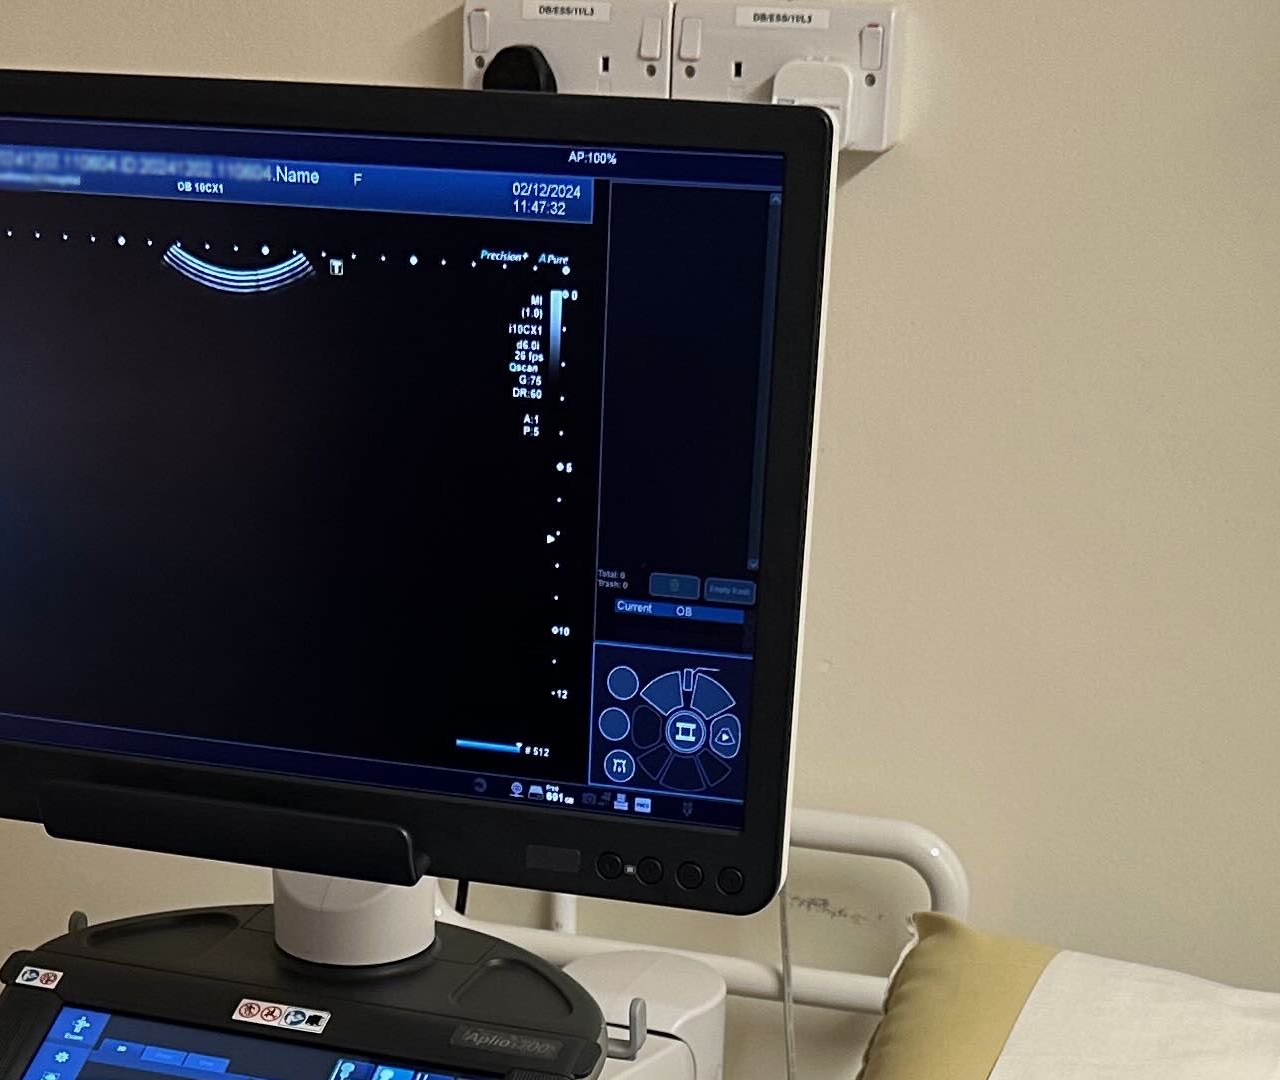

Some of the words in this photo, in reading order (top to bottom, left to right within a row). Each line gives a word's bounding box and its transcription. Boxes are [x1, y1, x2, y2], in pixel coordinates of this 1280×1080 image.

[568, 151, 617, 165] AP:100%
[353, 172, 362, 187] F
[177, 181, 192, 193] OB
[194, 182, 224, 194] 10CX1
[512, 182, 581, 199] 02/12/2024
[513, 200, 566, 215] 11:47:32
[571, 289, 578, 301] 0
[521, 307, 543, 320] (1.0)
[528, 352, 544, 363] fps
[513, 387, 542, 399] DR:60
[523, 414, 539, 424] A:1
[617, 600, 652, 614] Current
[676, 605, 692, 617] OB
[559, 626, 570, 636] 10
[557, 689, 568, 699] 12
[533, 746, 549, 757] 512
